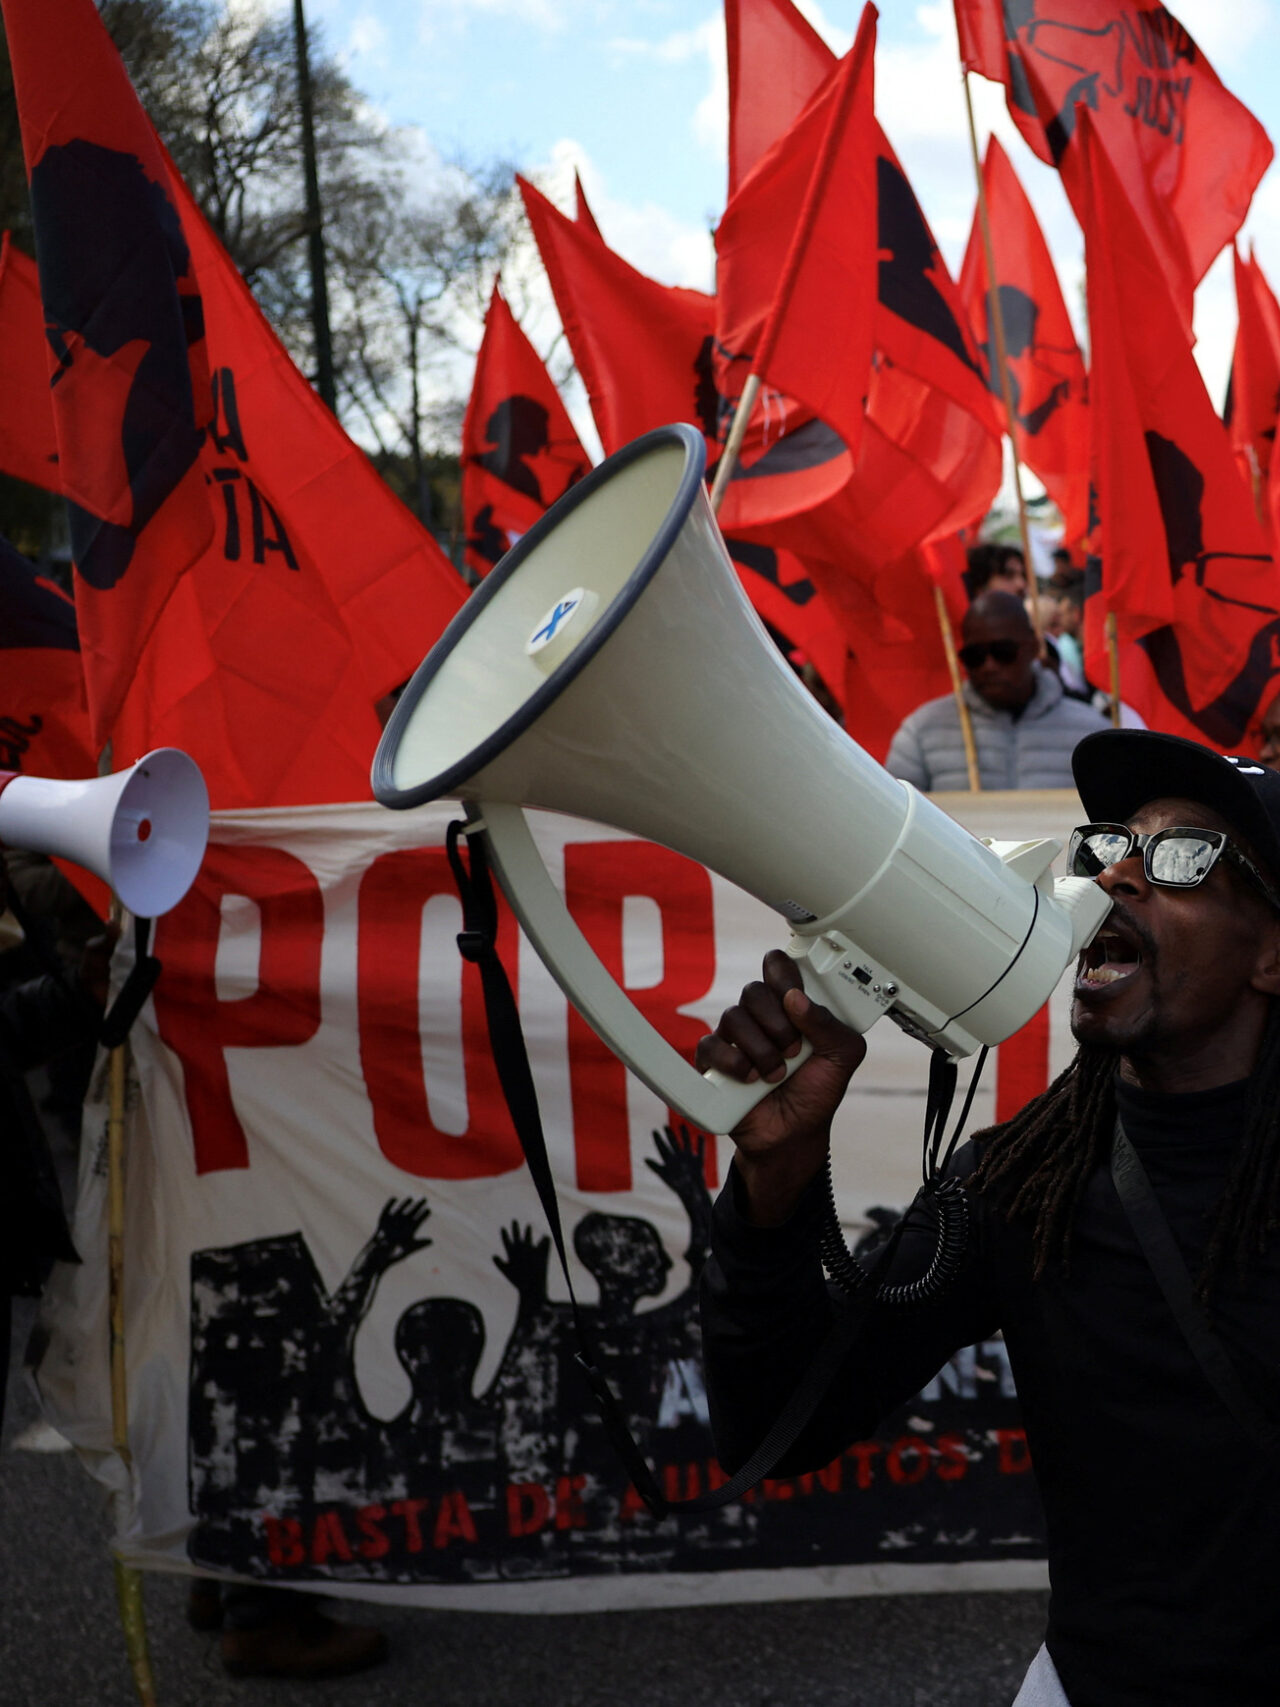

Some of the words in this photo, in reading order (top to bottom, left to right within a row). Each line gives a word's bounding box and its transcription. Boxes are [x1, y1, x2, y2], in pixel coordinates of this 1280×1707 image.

[152, 838, 720, 1193] POR
[264, 1489, 479, 1567] BASTA
[504, 1475, 590, 1539] DE
